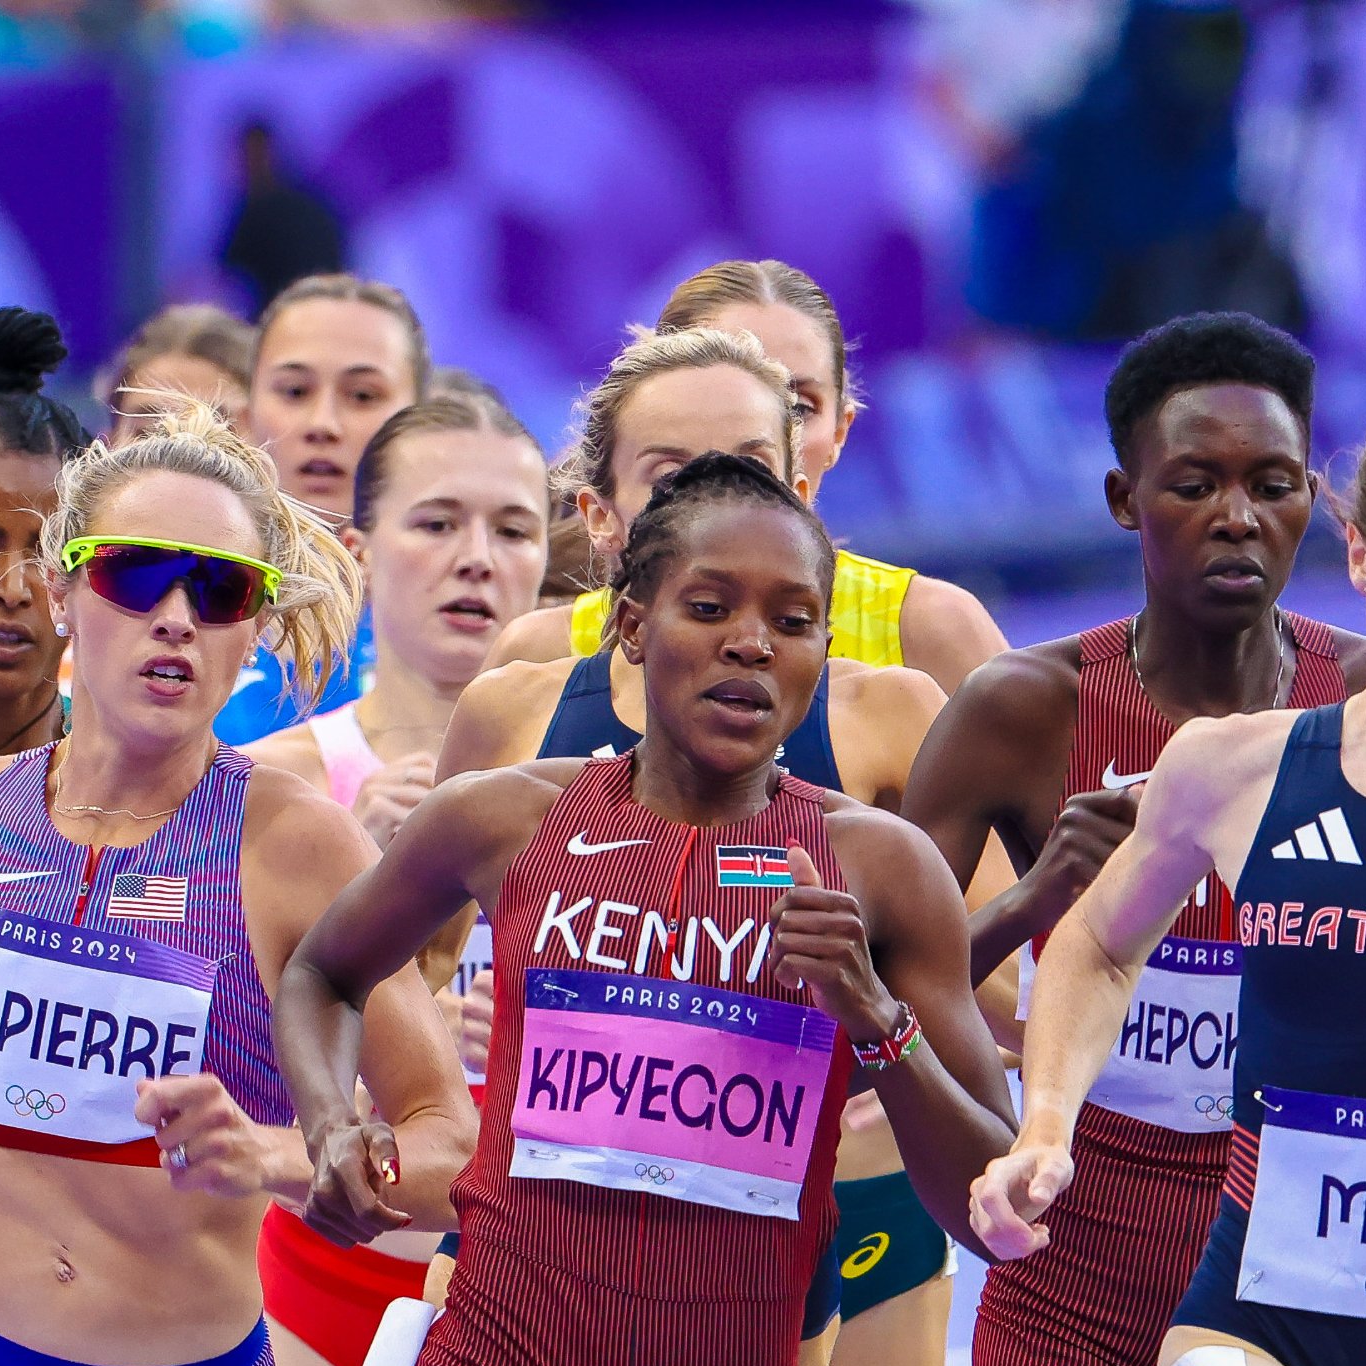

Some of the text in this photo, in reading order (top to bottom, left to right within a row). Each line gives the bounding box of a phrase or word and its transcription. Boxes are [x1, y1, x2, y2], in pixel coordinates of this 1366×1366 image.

[70, 936, 136, 964] 2024
[690, 997, 758, 1026] 2024
[526, 1047, 805, 1148] KIPYEGON
